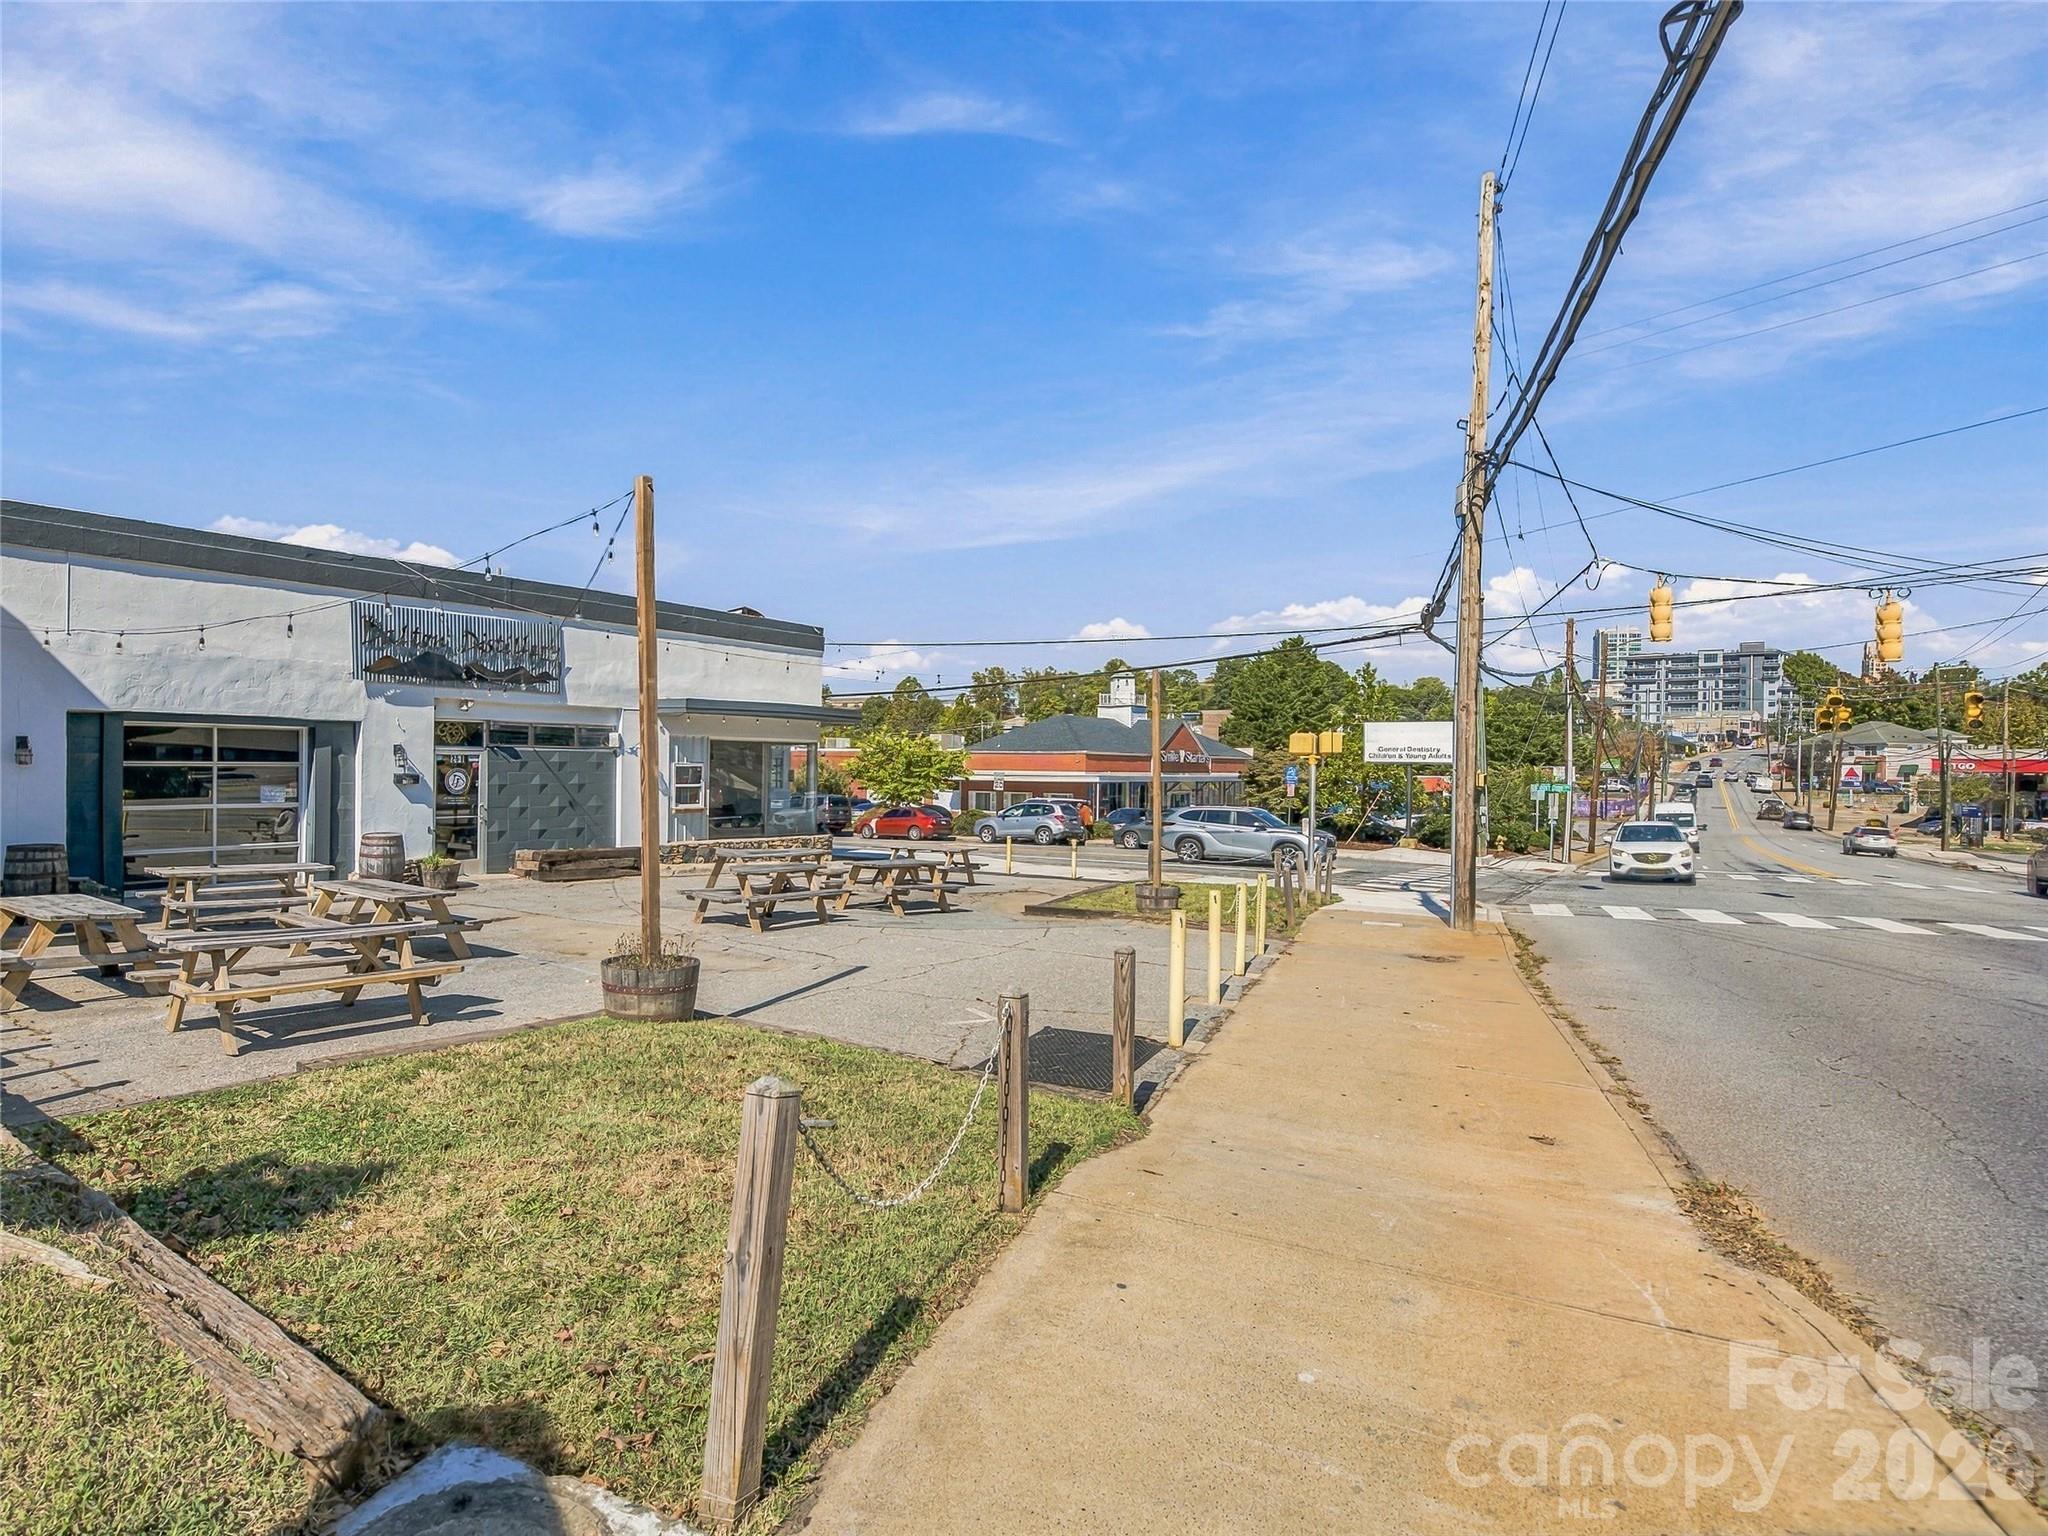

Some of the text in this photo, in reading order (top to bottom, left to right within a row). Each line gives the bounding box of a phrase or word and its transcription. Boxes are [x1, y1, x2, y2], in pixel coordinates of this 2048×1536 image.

[1407, 746, 1441, 755] Dentistry
[1160, 750, 1180, 762] Smile
[1406, 753, 1427, 761] Young
[1949, 762, 1976, 770] TGO
